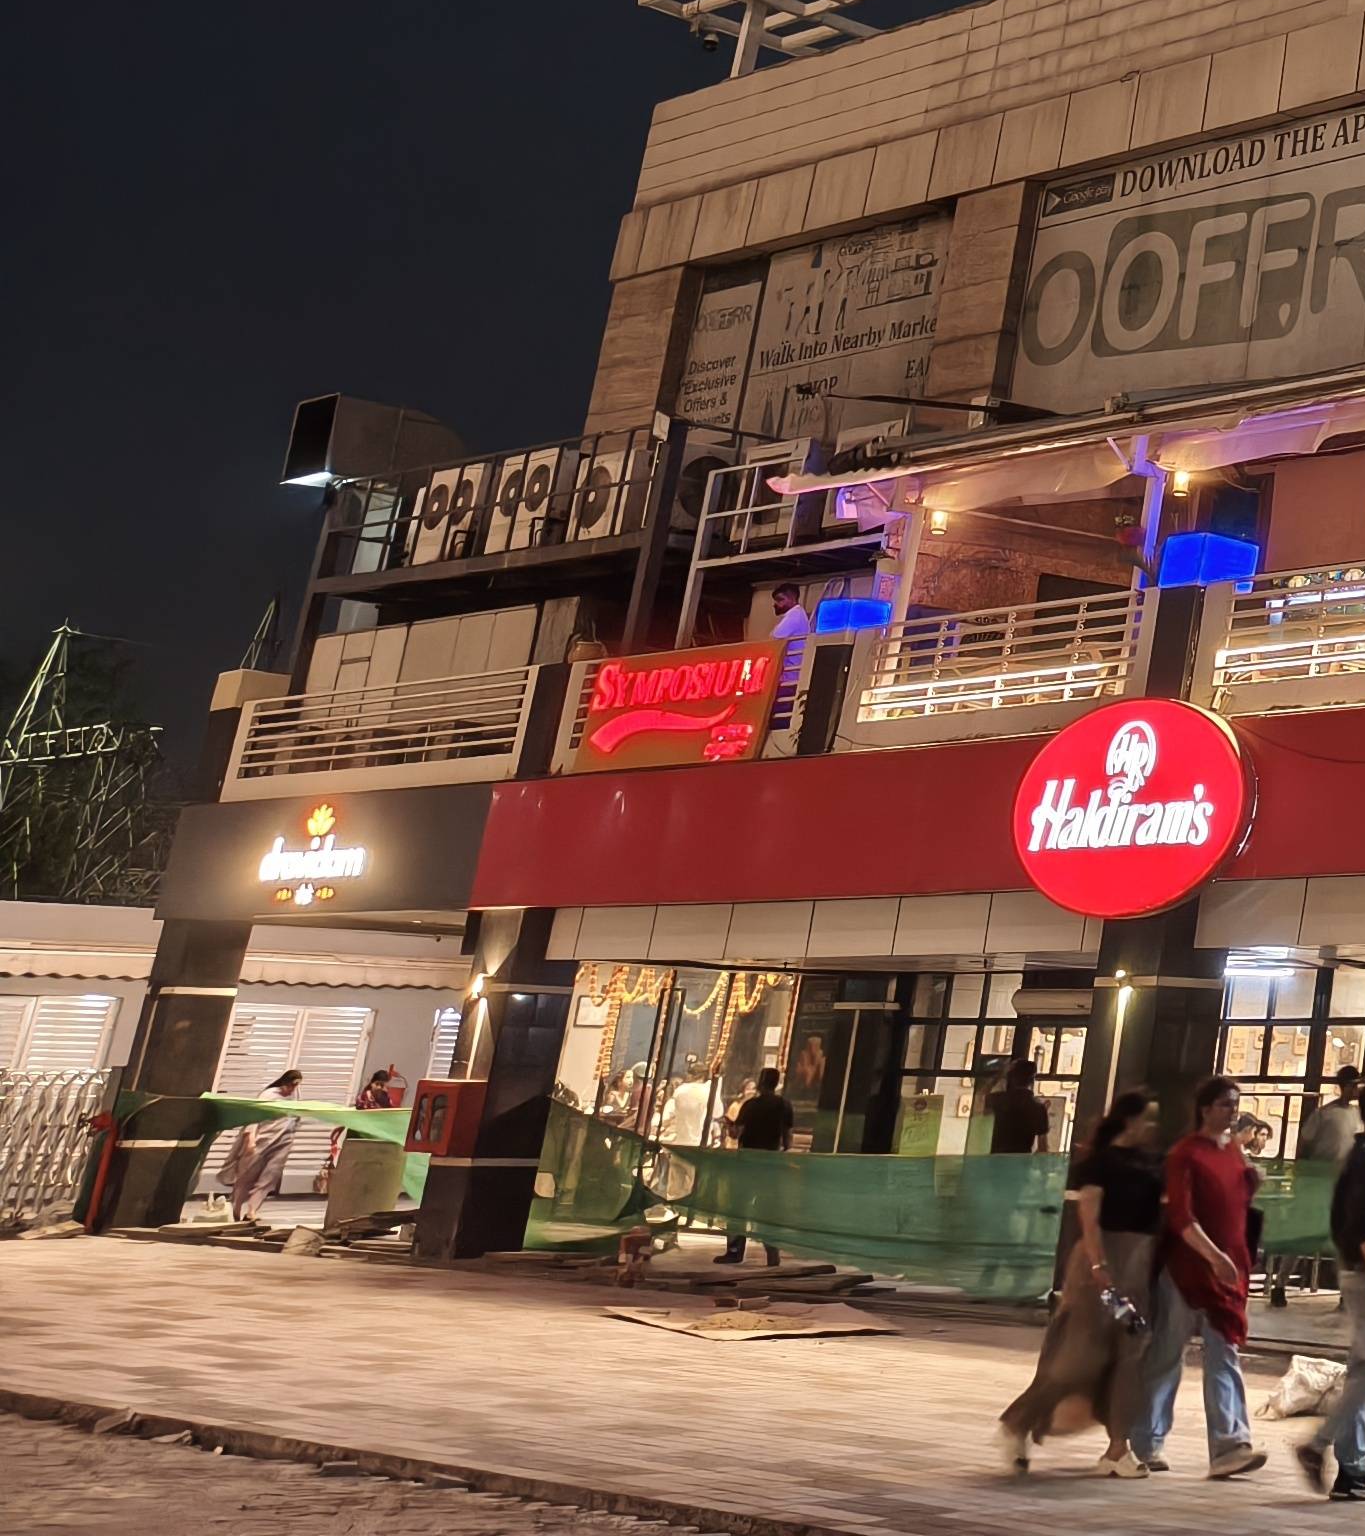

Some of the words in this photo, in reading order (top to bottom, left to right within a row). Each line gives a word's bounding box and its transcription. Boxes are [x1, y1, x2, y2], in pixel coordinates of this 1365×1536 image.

[1119, 138, 1266, 199] DOWNLOAD
[1272, 122, 1328, 161] THE
[687, 355, 737, 375] Discover
[760, 341, 795, 369] Walk
[798, 340, 828, 361] Into
[831, 325, 886, 354] Nearby
[888, 314, 938, 341] Marke
[683, 373, 737, 396] Exclusive
[592, 656, 771, 712] SYMPOSIUM
[1027, 778, 1215, 852] Haldiram's
